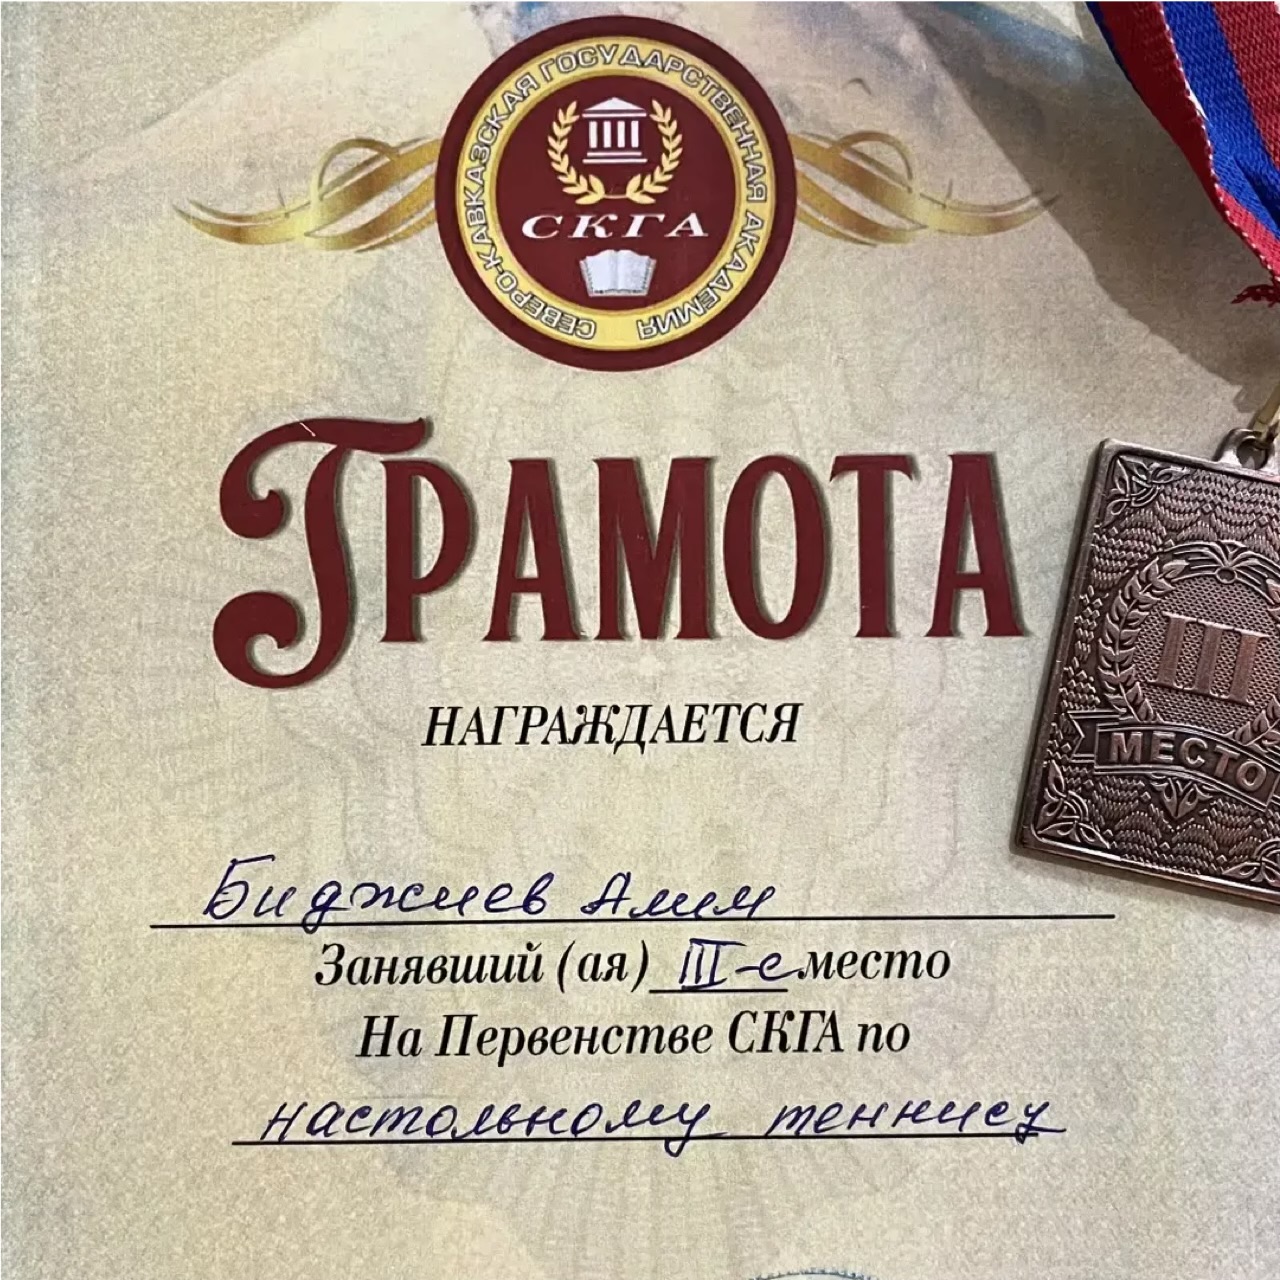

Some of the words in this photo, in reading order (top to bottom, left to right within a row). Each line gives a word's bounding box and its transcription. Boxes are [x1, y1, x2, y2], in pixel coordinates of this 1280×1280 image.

[539, 44, 768, 204] ГОСУДАРСТВЕННАЯ
[463, 73, 596, 340] СЕВЕРО-КАВКАЗСКАЯ
[521, 212, 709, 239] СКГА
[636, 210, 765, 340] АКАДЕМИЯ
[212, 416, 1028, 689] ГРАМОТА
[421, 702, 804, 755] НАГРАЖДАЕТСЯ
[1110, 731, 1268, 792] МЕСТО
[314, 940, 545, 988] Занявший
[555, 943, 650, 991] (ая)
[797, 949, 952, 983] место
[355, 1014, 422, 1060] На
[434, 1014, 715, 1069] Первенстве
[727, 1011, 846, 1056] СКГА
[856, 1024, 911, 1056] по
